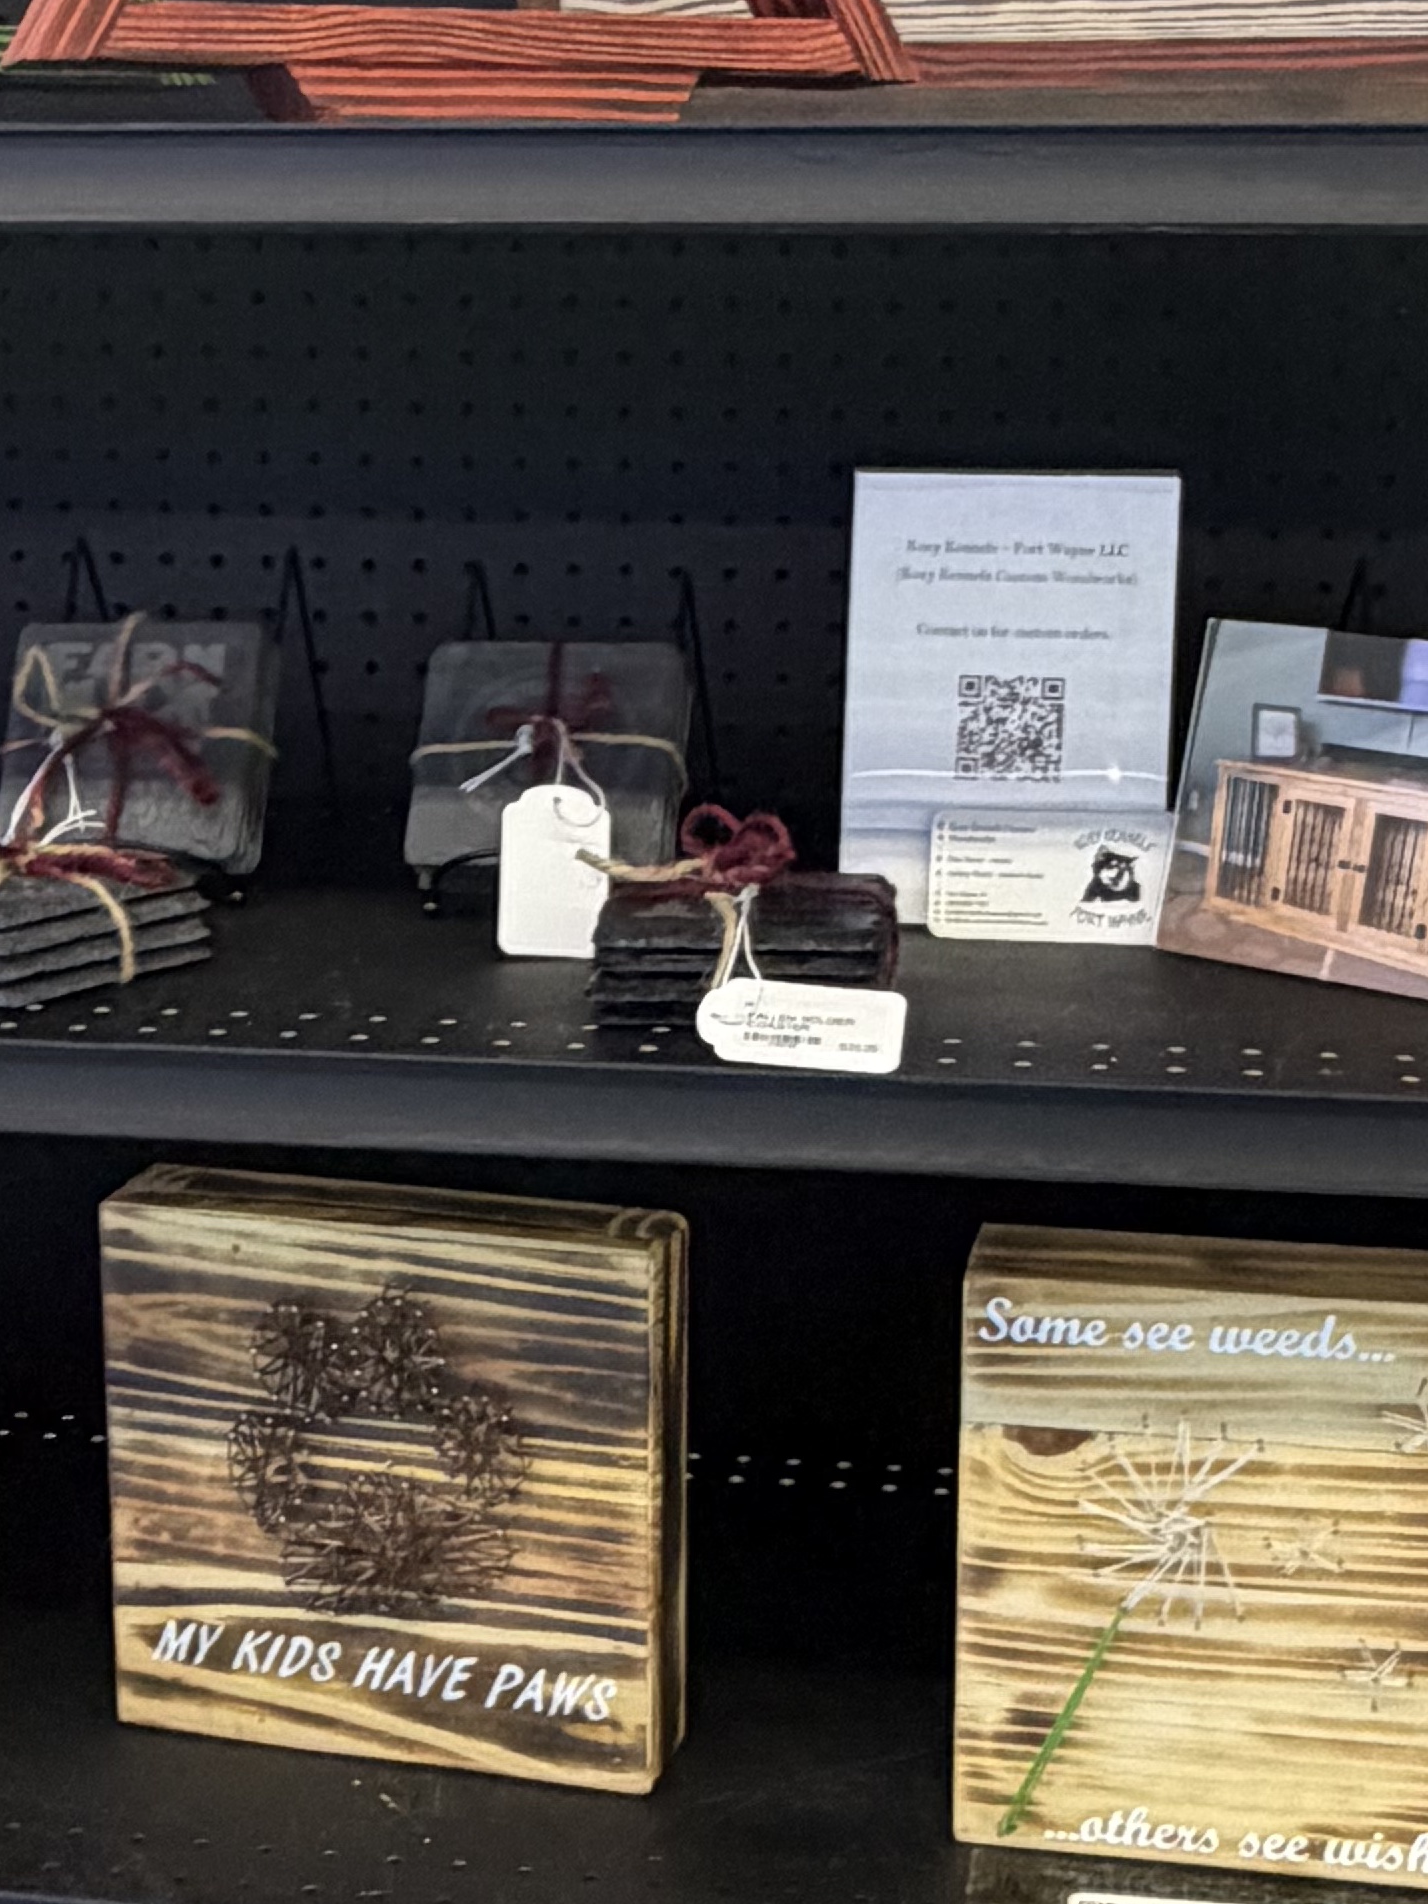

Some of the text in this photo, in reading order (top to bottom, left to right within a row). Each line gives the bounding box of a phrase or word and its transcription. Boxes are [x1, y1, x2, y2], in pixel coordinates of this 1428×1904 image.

[977, 1296, 1108, 1348] Some
[1121, 1322, 1195, 1352] see
[151, 1619, 619, 1721] MY KIDS HAVE PAWS
[1237, 1829, 1310, 1864] see
